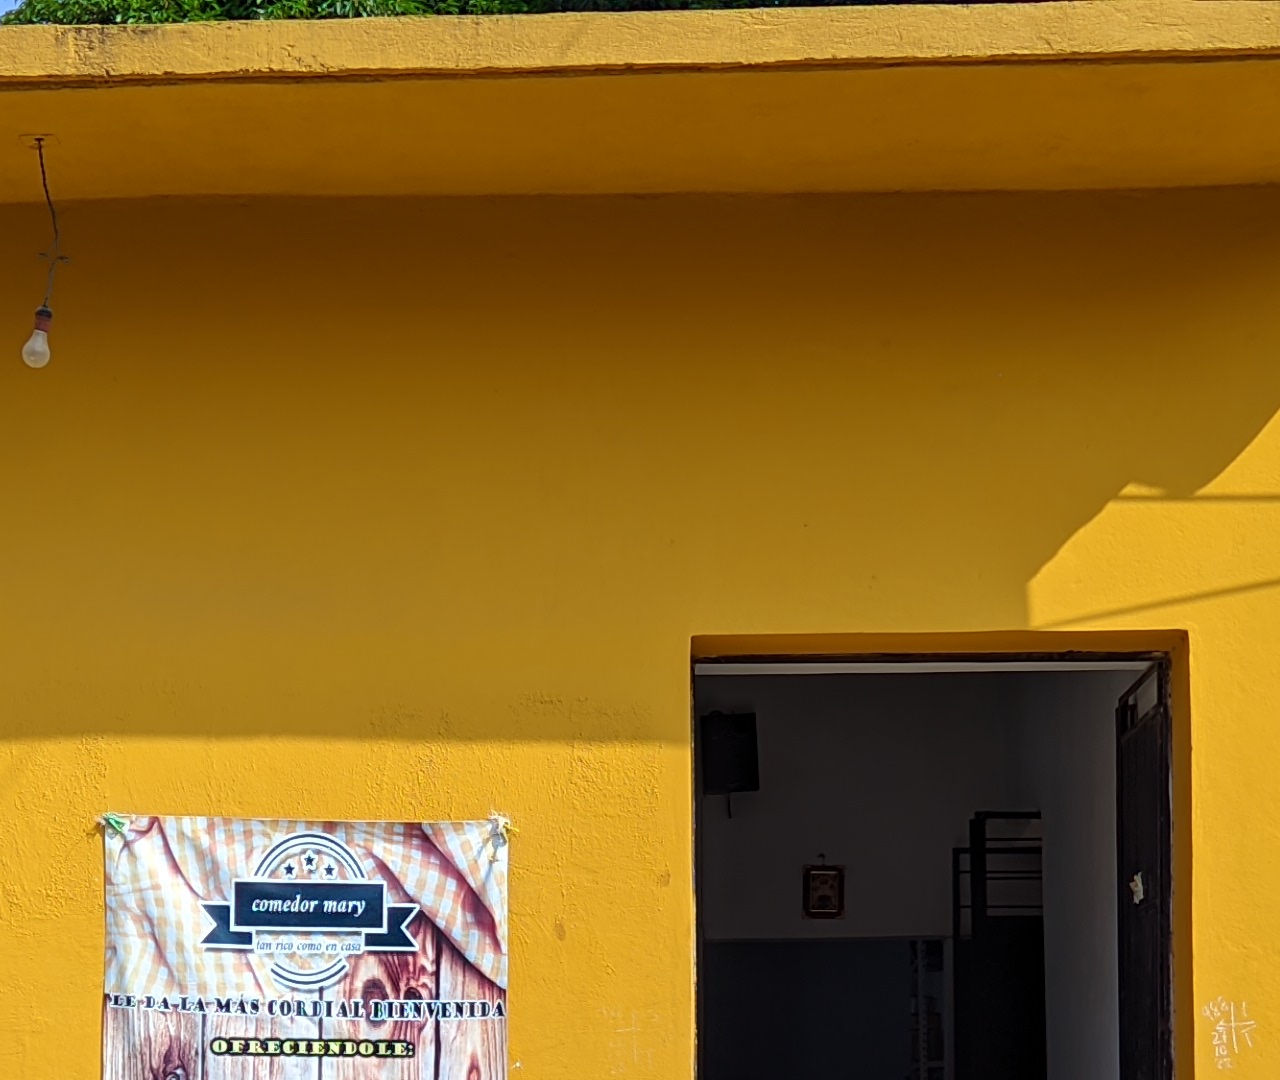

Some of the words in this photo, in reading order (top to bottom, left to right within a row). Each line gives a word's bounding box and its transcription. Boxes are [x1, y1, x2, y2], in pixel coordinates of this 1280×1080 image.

[252, 895, 318, 913] comedor
[323, 899, 366, 917] mary
[256, 940, 272, 950] tan
[275, 940, 294, 951] rico
[296, 941, 322, 952] como
[325, 944, 337, 952] en
[340, 942, 362, 952] casa
[111, 995, 136, 1007] LE
[144, 997, 171, 1010] DA
[179, 996, 206, 1013] LA
[268, 999, 365, 1018] CORDIAL
[371, 1000, 506, 1019] BIENVENIDA
